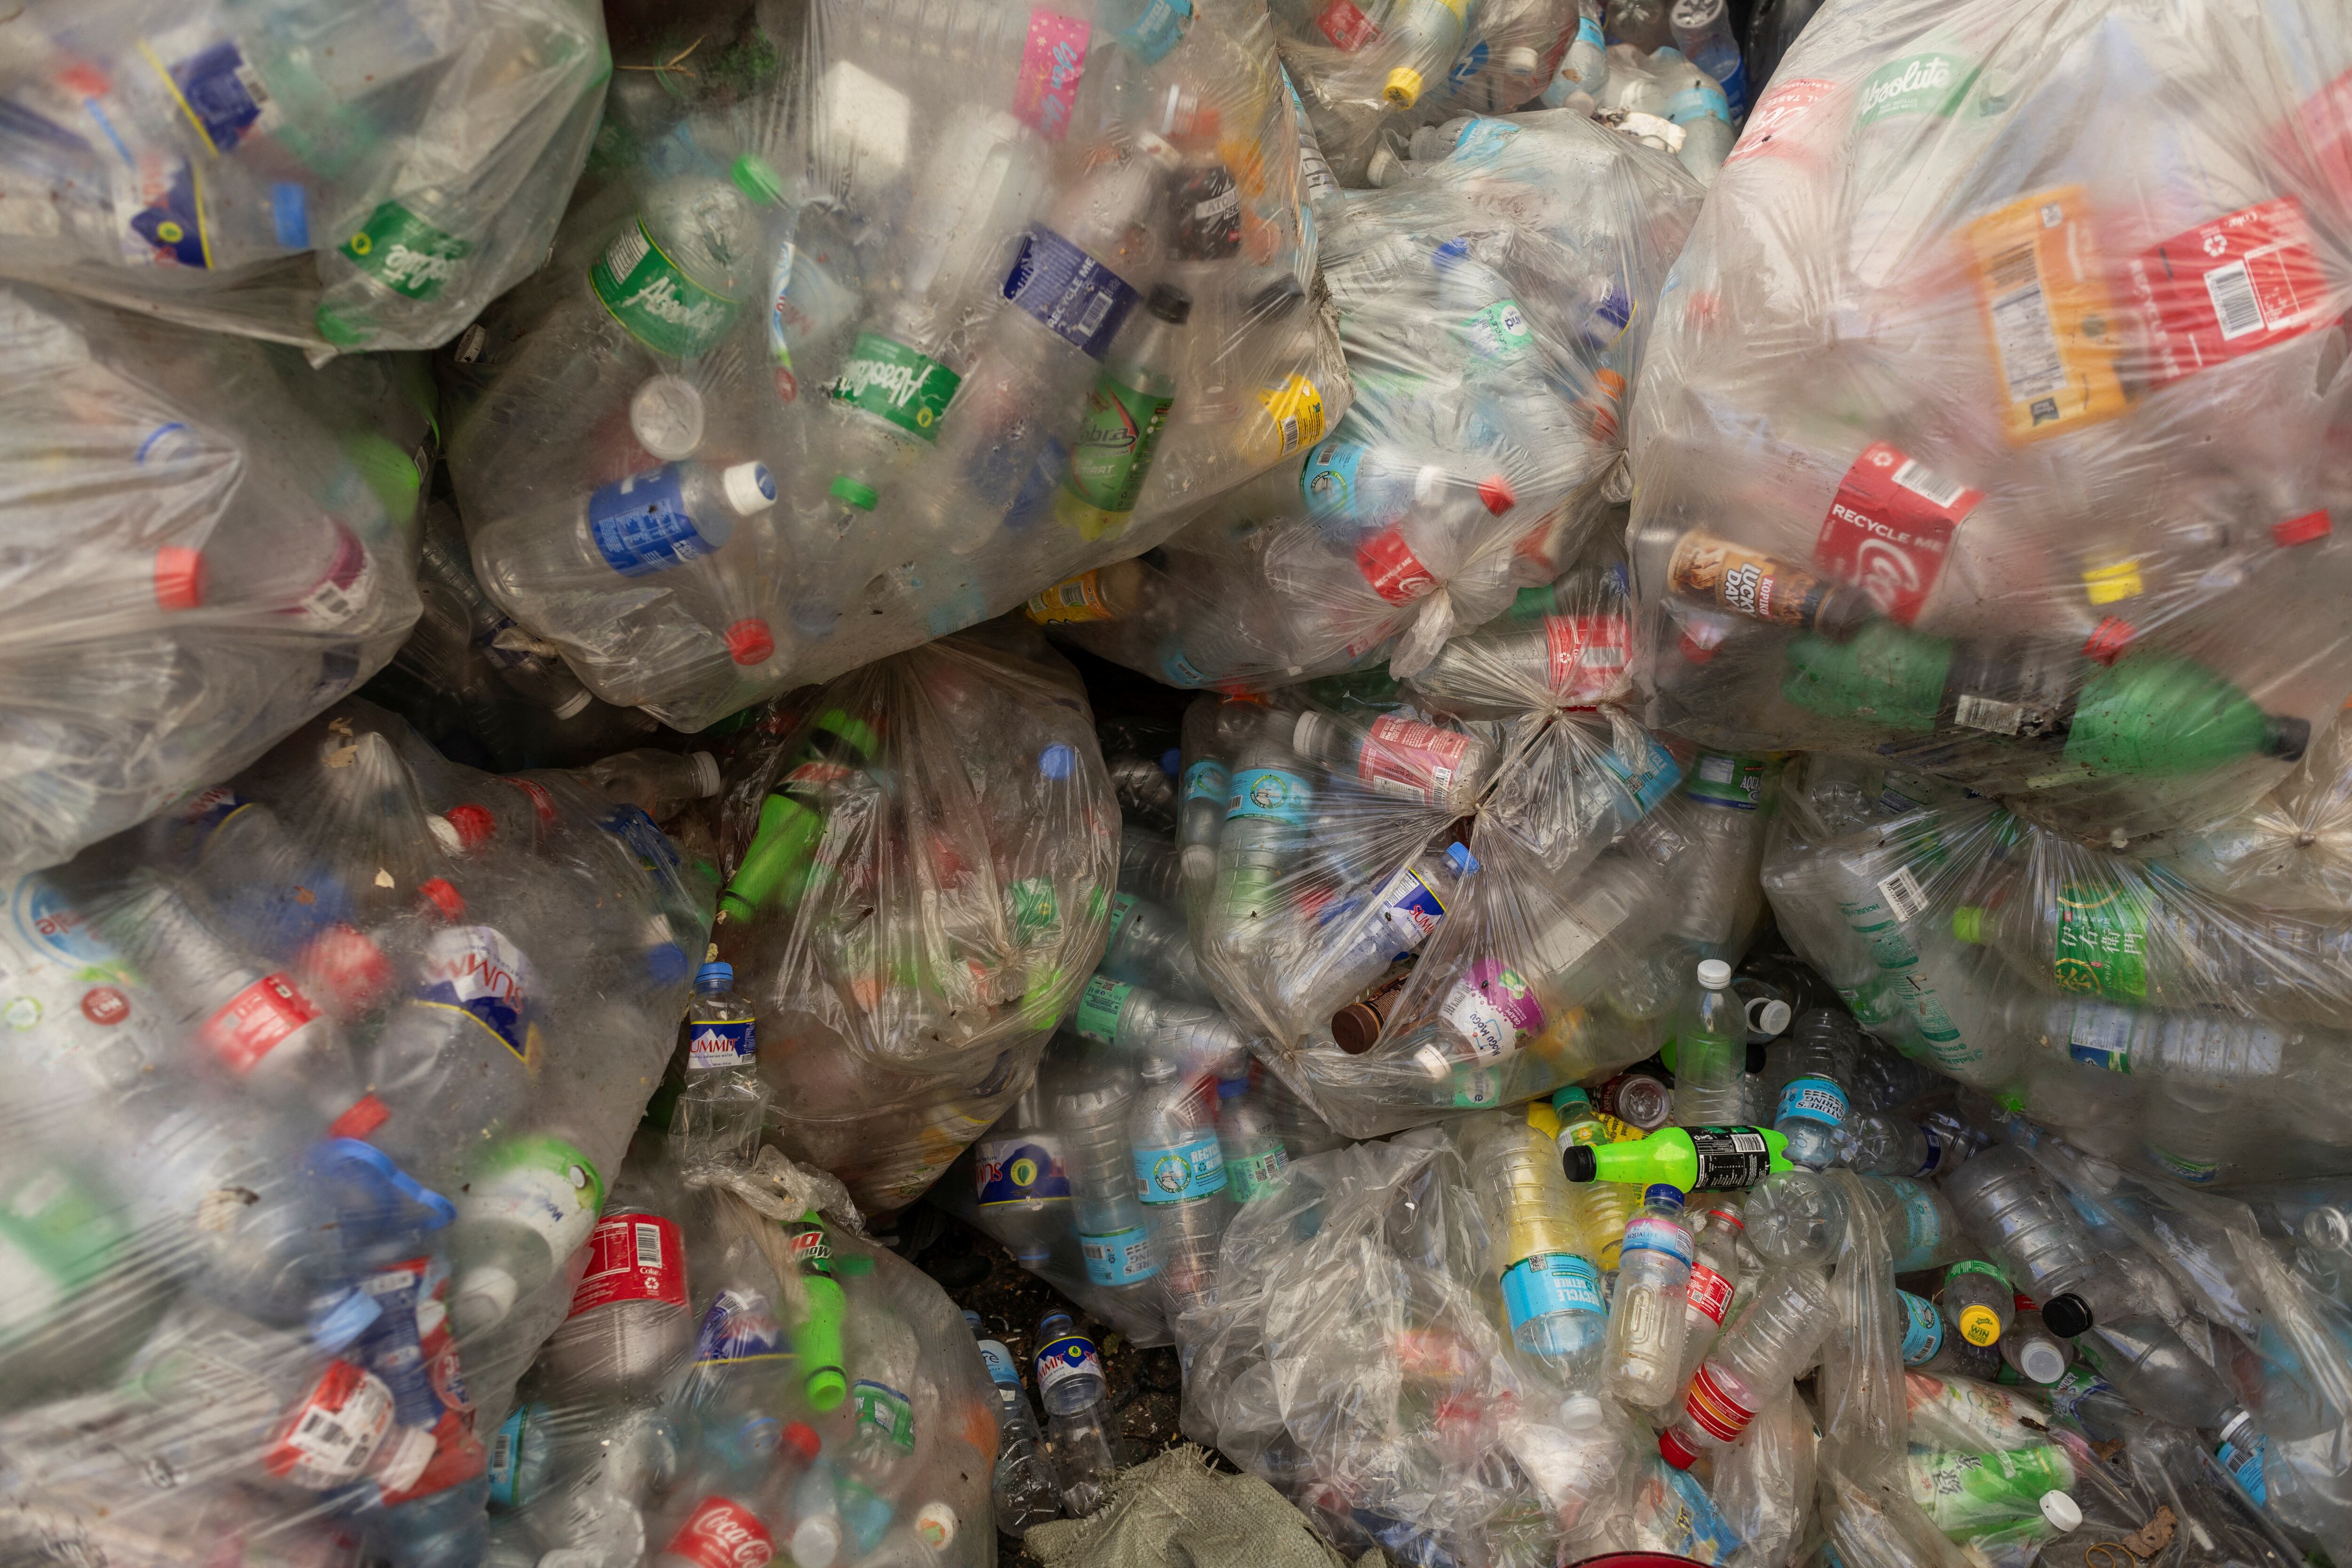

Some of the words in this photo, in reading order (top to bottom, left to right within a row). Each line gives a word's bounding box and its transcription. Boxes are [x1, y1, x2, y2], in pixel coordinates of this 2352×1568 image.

[1047, 276, 1083, 329] RECYCLE
[1078, 256, 1096, 279] ME
[1311, 470, 1329, 489] RECYCLE
[1832, 503, 1911, 544] RECYCLE
[1915, 537, 1944, 553] ME
[1401, 556, 1413, 568] ME
[1724, 568, 1743, 608] DAY
[1740, 563, 1763, 618] LUCKY
[1759, 577, 1774, 616] KOPIKO
[1253, 776, 1266, 788] TWIST
[1277, 779, 1287, 789] FLIP
[1740, 775, 1759, 793] AQUA
[1251, 793, 1264, 808] RECYCLE
[1272, 800, 1284, 808] LOCK
[1859, 903, 1881, 915] HOUSE
[1470, 1013, 1490, 1037] MOGU
[1505, 1007, 1521, 1025] GRAPE
[690, 1038, 738, 1053] UMMIT
[1486, 1035, 1501, 1057] MOGU
[1804, 1096, 1844, 1116] SPRING
[1154, 1158, 1165, 1171] TWIST
[1176, 1156, 1188, 1167] FLIP
[1155, 1177, 1173, 1194] RECYCLE
[1181, 1176, 1192, 1191] LOCK
[1626, 1231, 1659, 1241] AQUALIFE
[639, 1267, 659, 1275] Coke
[1971, 1324, 1990, 1337] WIN
